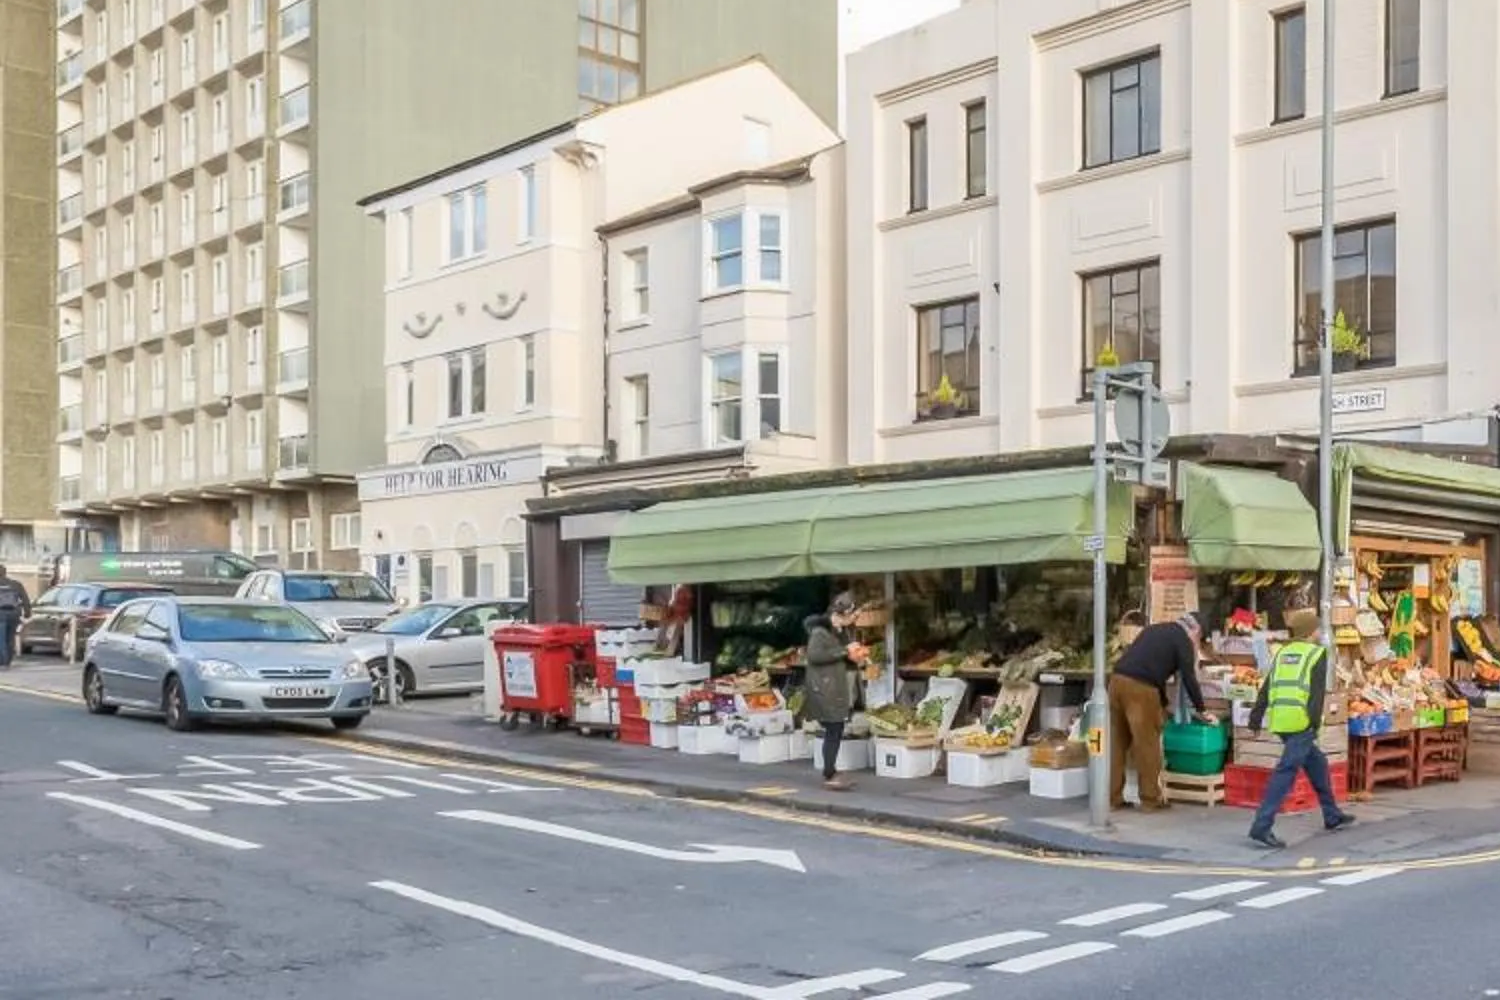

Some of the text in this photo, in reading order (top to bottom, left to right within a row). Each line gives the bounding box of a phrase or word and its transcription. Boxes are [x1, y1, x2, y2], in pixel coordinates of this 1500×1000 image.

[1349, 392, 1382, 407] STREET
[385, 461, 507, 494] HELP FOR HEARING
